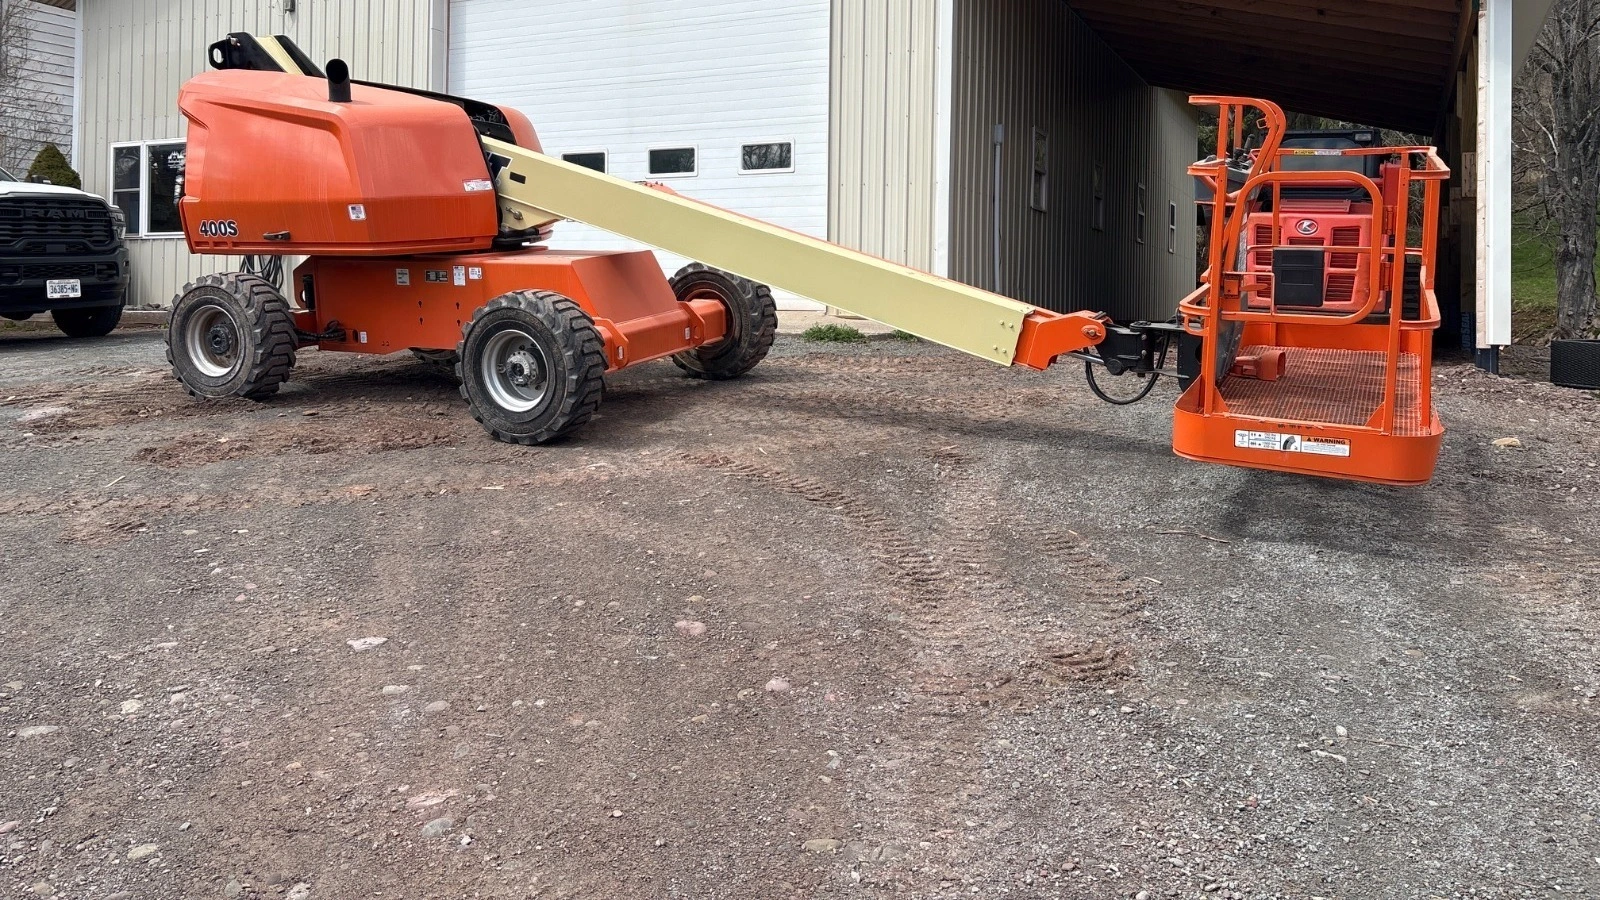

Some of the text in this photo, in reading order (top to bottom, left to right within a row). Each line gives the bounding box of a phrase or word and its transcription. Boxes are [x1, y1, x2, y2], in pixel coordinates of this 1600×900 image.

[25, 208, 85, 218] RAM
[199, 220, 238, 237] 400S
[1314, 437, 1346, 445] WARNING
